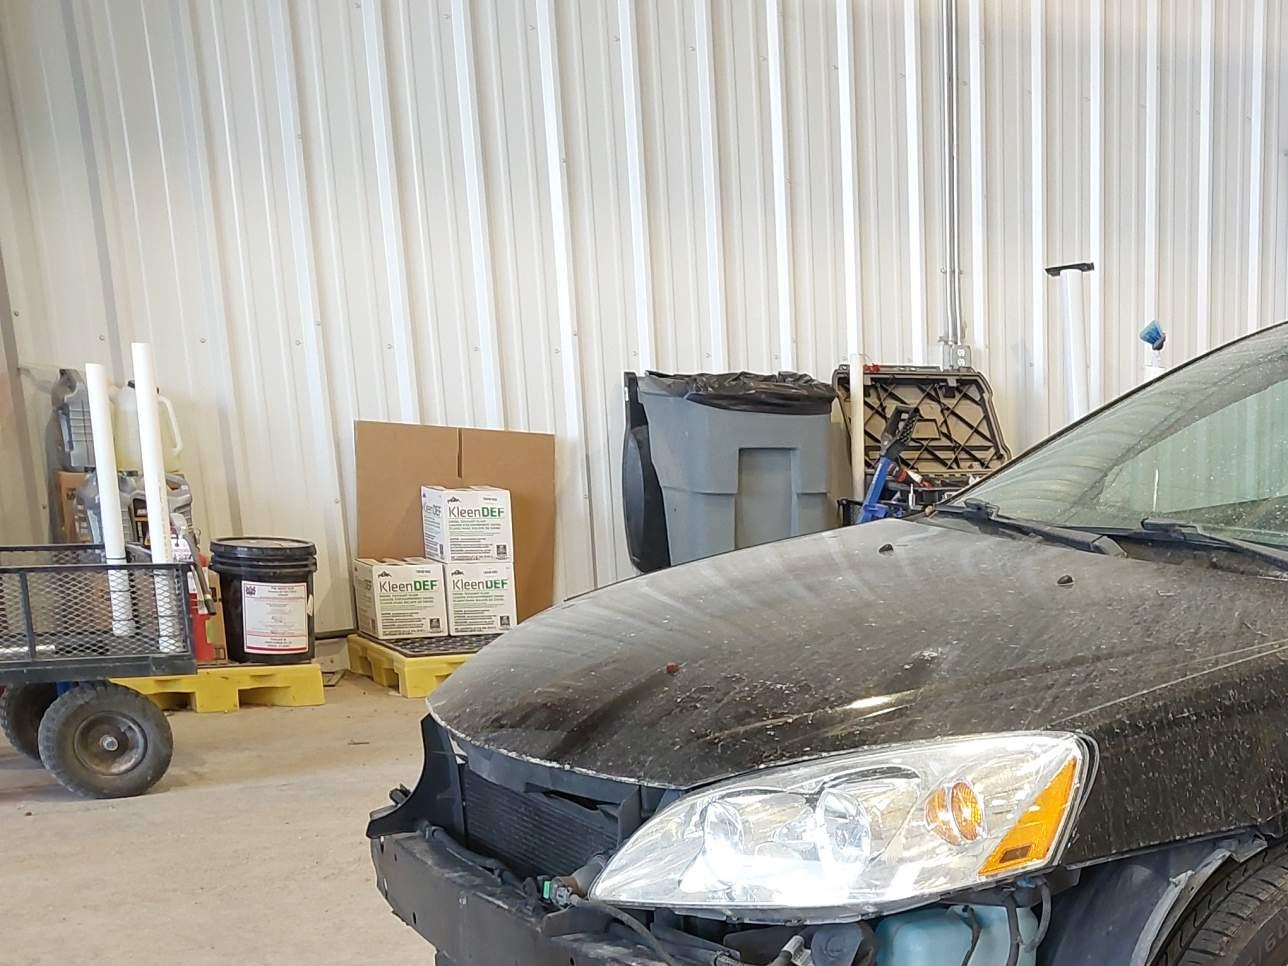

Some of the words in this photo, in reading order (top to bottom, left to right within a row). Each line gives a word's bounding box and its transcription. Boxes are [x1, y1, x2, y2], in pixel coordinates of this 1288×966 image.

[448, 506, 505, 518] KleenDEF
[379, 580, 438, 593] KleenDEF
[452, 579, 509, 591] KleenDEF
